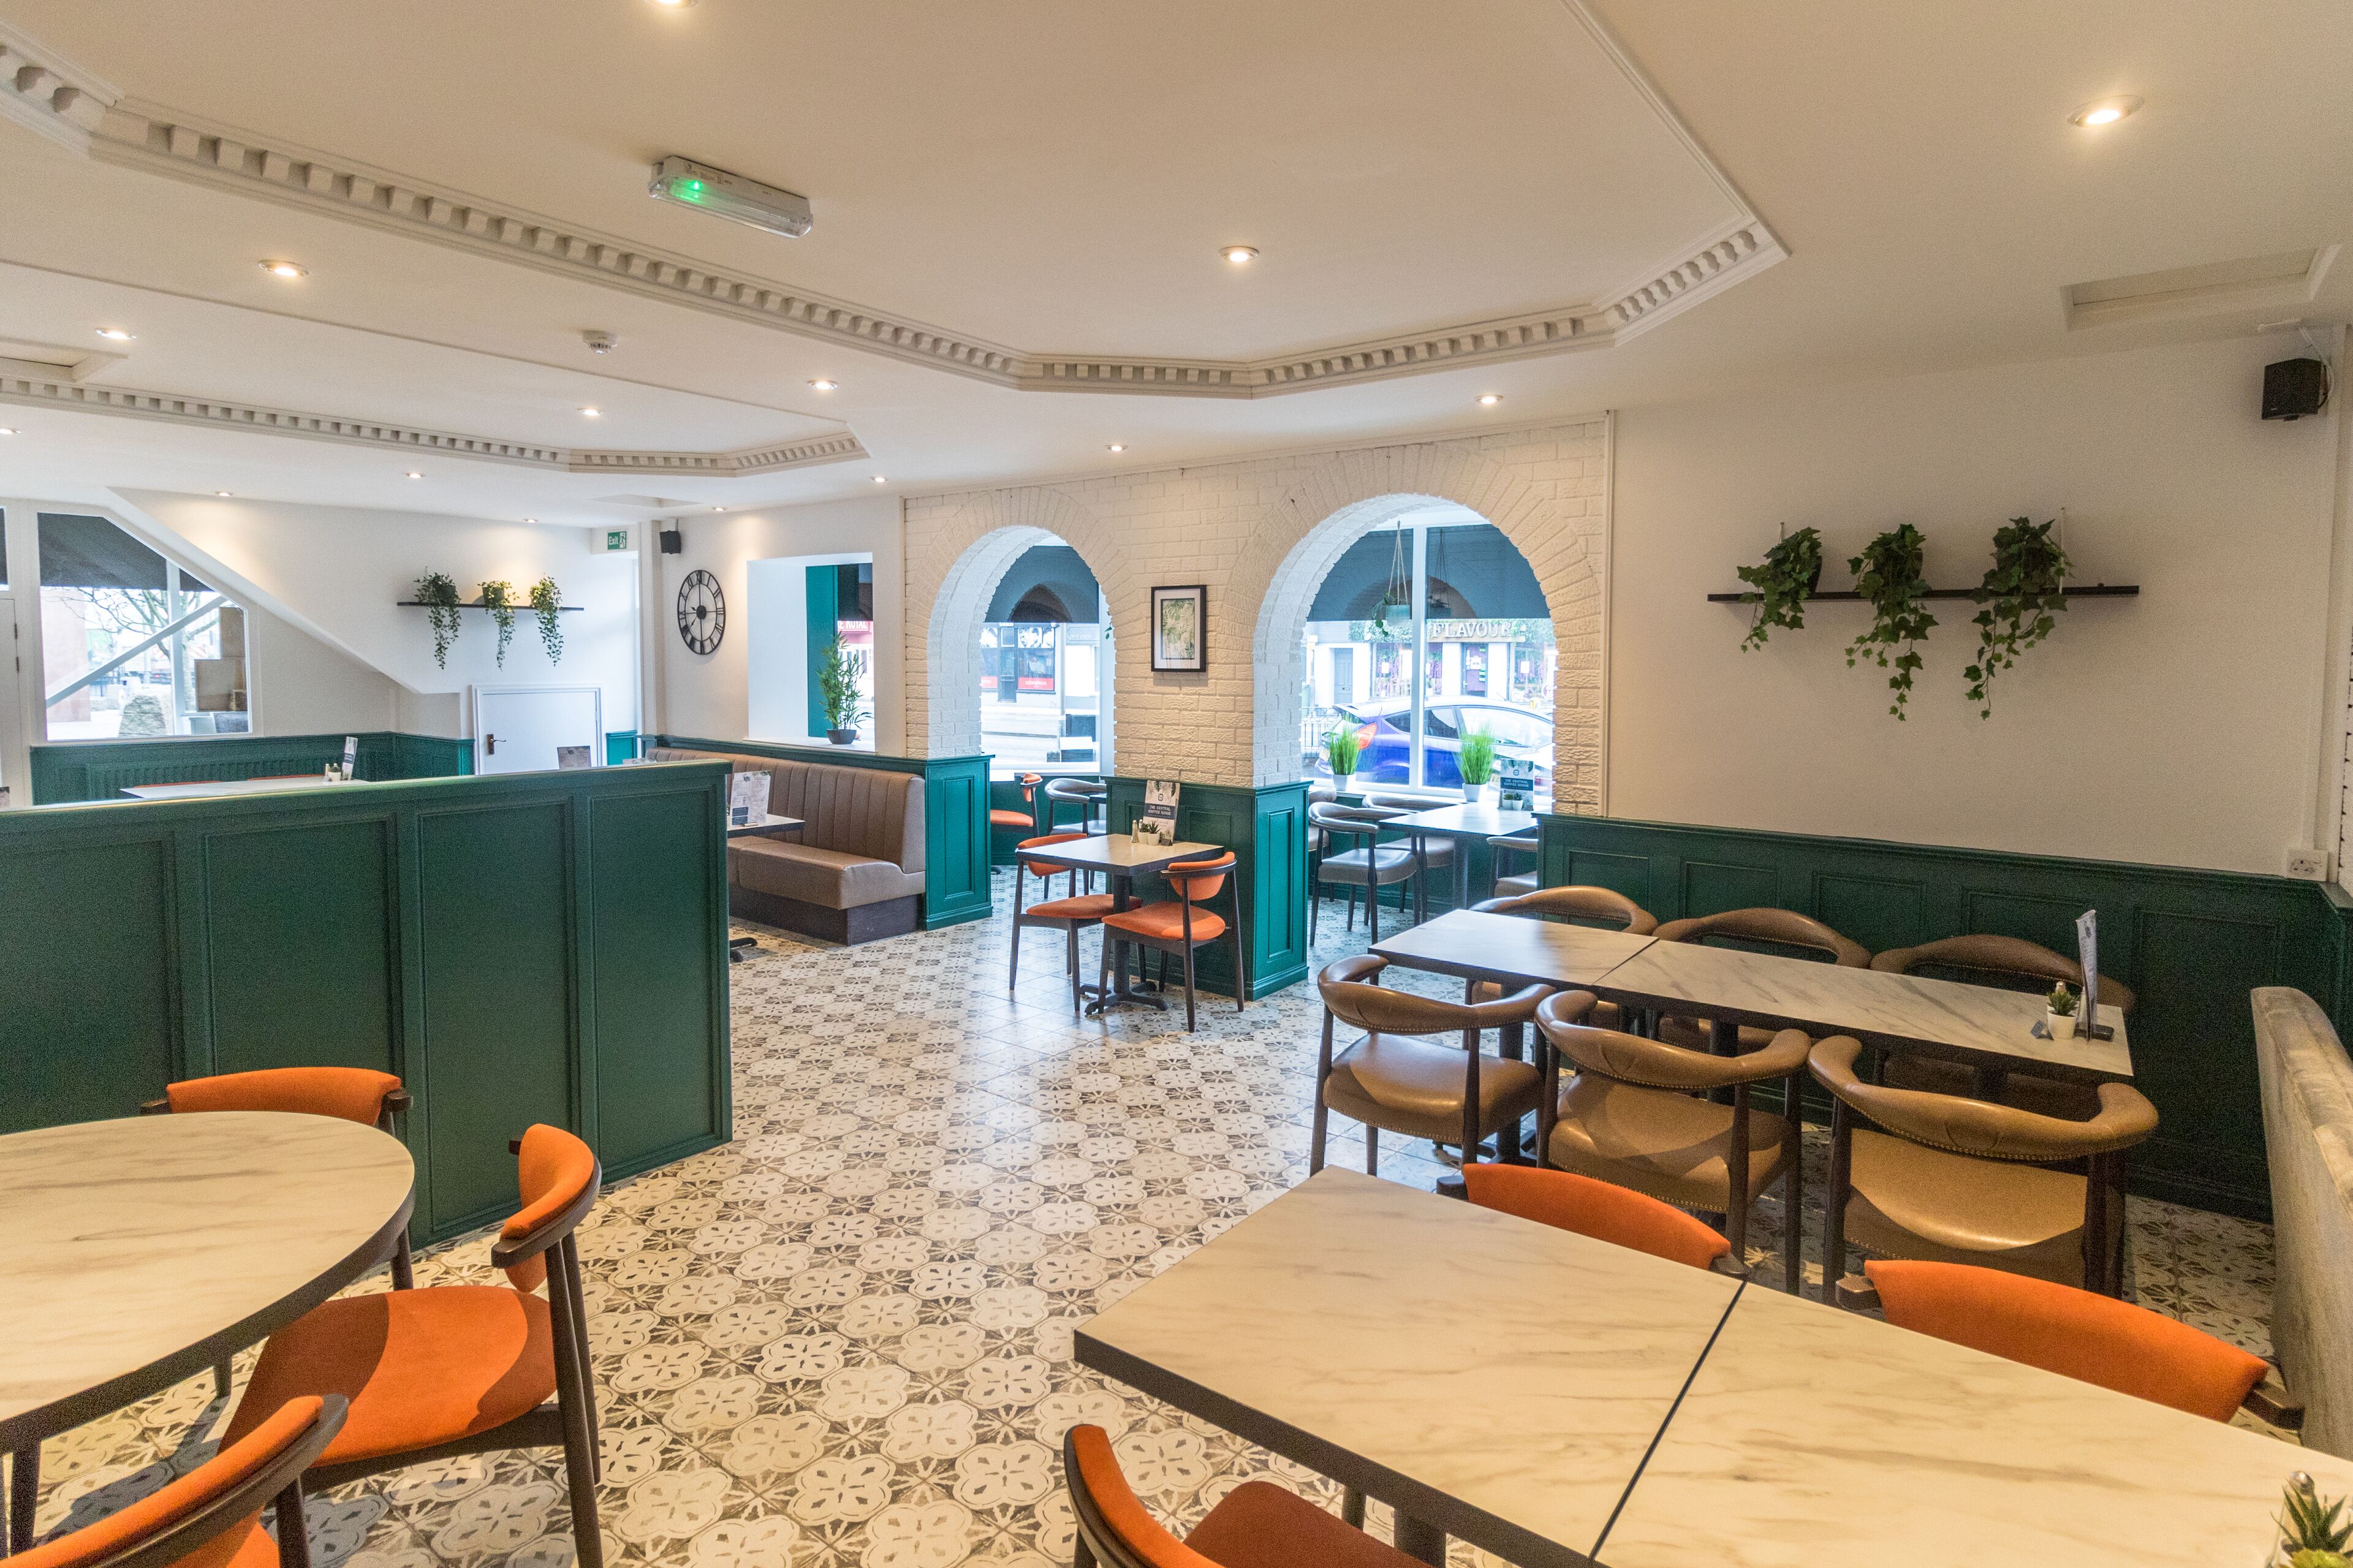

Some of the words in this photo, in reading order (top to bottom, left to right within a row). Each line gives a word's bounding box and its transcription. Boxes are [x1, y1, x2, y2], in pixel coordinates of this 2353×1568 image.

[608, 536, 618, 545] Exit
[846, 621, 867, 629] ROYAL
[1431, 621, 1511, 638] FLAVOUR
